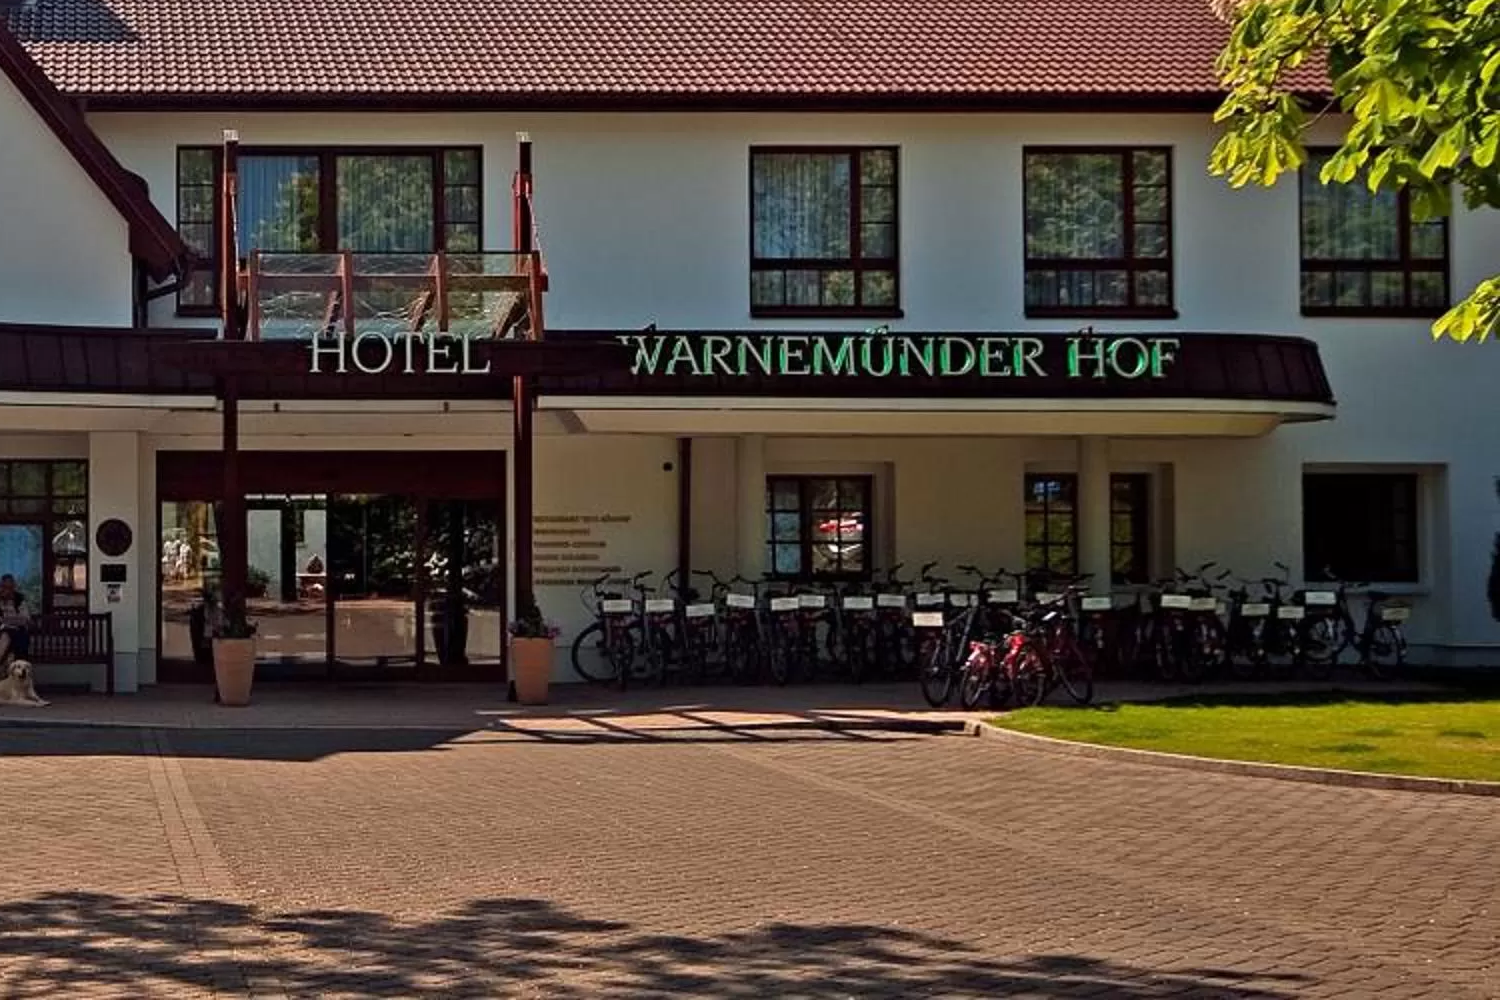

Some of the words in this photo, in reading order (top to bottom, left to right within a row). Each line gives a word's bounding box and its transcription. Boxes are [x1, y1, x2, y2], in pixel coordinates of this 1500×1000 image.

[308, 331, 492, 374] HOTEL
[615, 327, 1048, 377] WARNEMÜNDER
[1066, 336, 1181, 378] HOF
